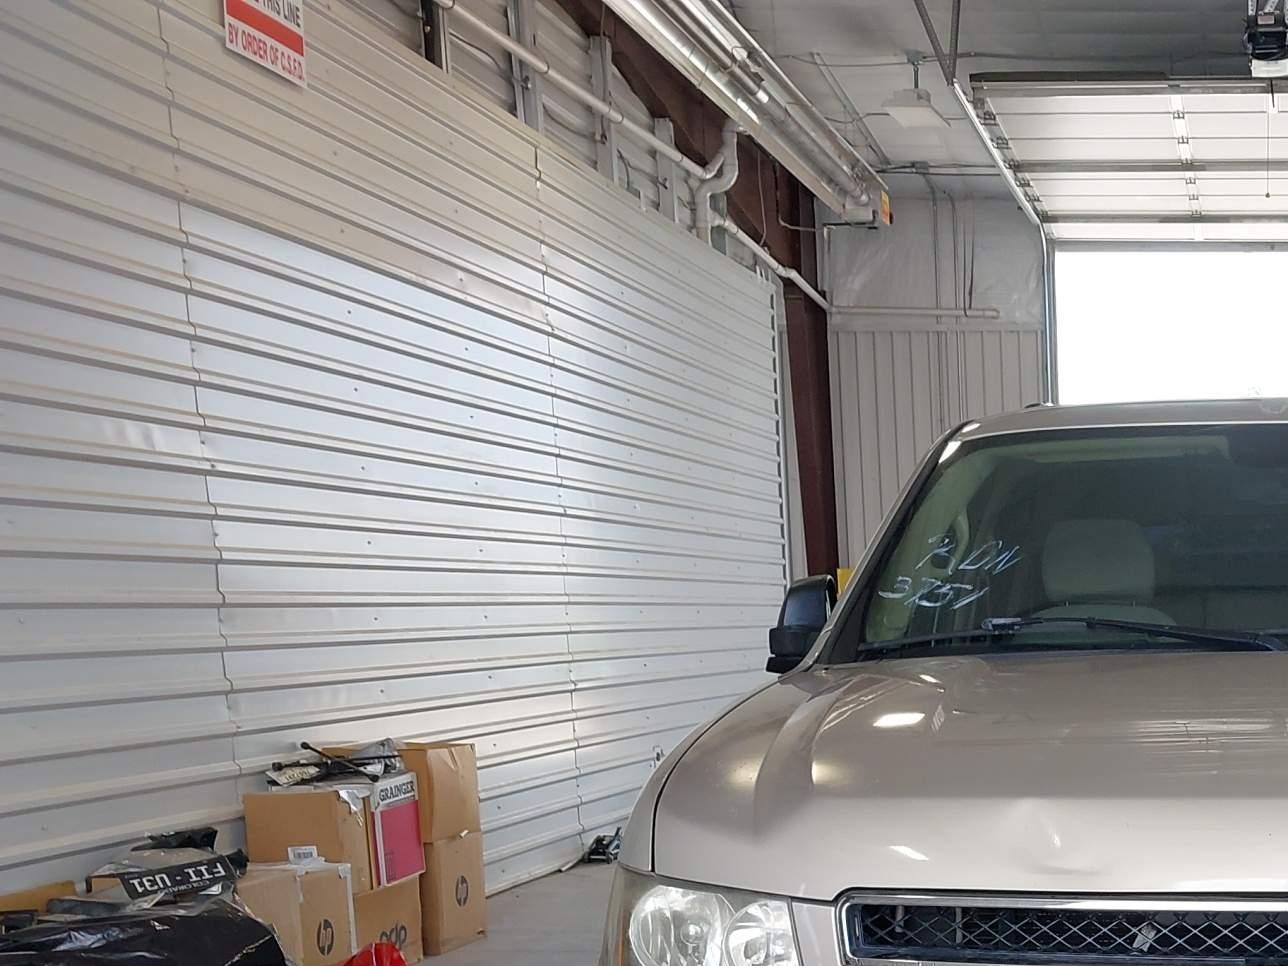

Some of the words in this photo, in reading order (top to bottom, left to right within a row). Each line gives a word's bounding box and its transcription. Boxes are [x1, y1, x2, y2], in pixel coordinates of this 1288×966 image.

[282, 0, 301, 28] LINE
[228, 22, 239, 47] BY
[241, 30, 268, 62] ORDER
[269, 44, 280, 67] OF
[379, 780, 416, 802] GRAINGER
[317, 918, 334, 956] hp
